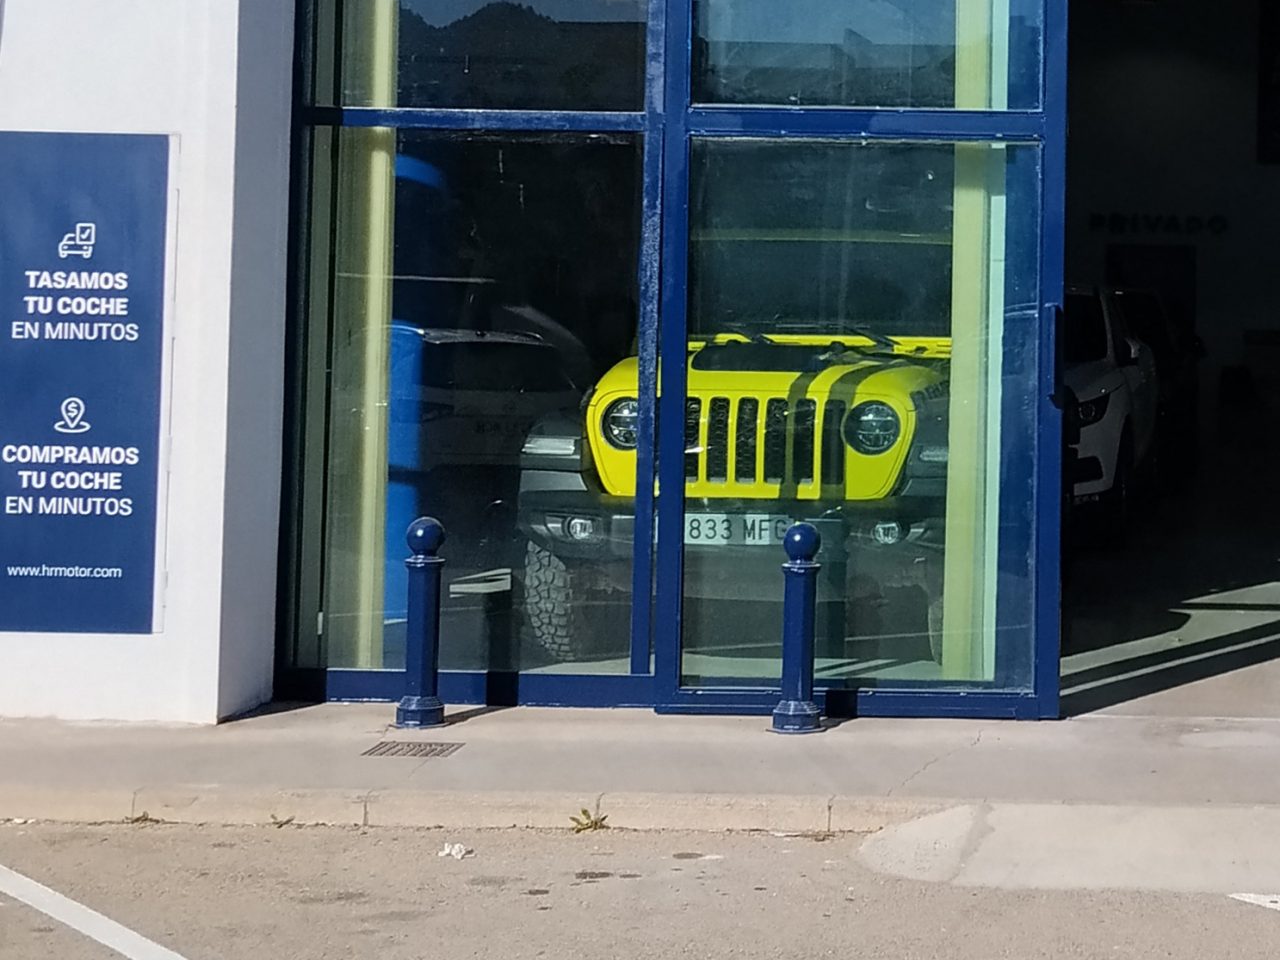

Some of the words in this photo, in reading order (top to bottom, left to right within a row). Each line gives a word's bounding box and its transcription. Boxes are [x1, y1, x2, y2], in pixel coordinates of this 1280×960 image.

[25, 271, 128, 290] TASAMOS
[24, 296, 53, 314] TU
[57, 297, 128, 315] COCHE
[11, 322, 39, 339] EN
[44, 322, 139, 341] MINUTOS
[2, 445, 139, 465] COMPRAMOS
[18, 471, 46, 489] TU
[51, 471, 121, 490] COCHE
[5, 497, 33, 514] EN
[38, 497, 133, 515] MINUTOS
[689, 519, 732, 539] 833
[7, 564, 122, 579] www.hrmotor.com
